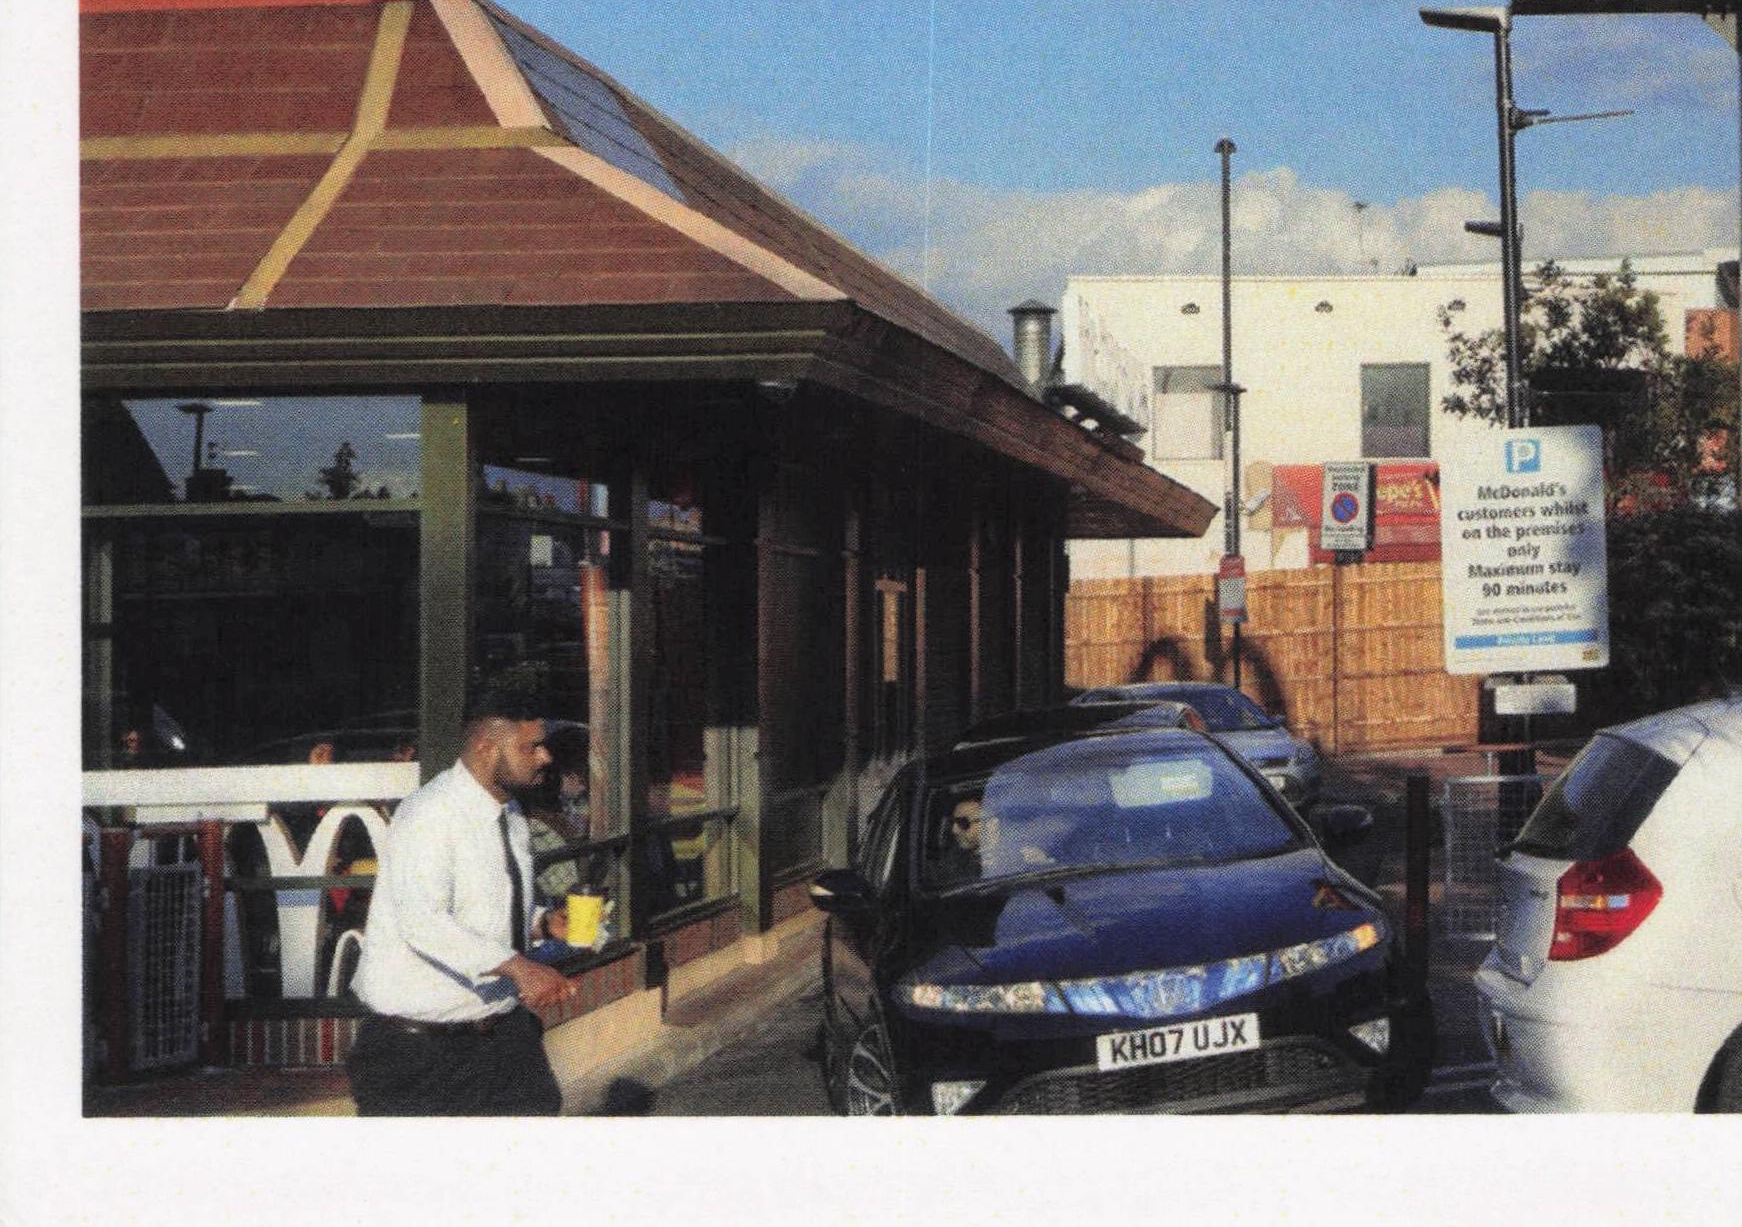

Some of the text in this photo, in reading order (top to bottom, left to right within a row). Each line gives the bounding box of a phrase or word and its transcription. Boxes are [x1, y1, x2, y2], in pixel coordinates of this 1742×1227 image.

[1477, 482, 1567, 500] McDonald's
[1458, 505, 1535, 522] customers
[1462, 520, 1585, 541] on the premises
[1468, 560, 1582, 578] Maximum stay
[1482, 580, 1567, 598] 90 minutes
[1110, 1019, 1247, 1064] KH07 UJX
